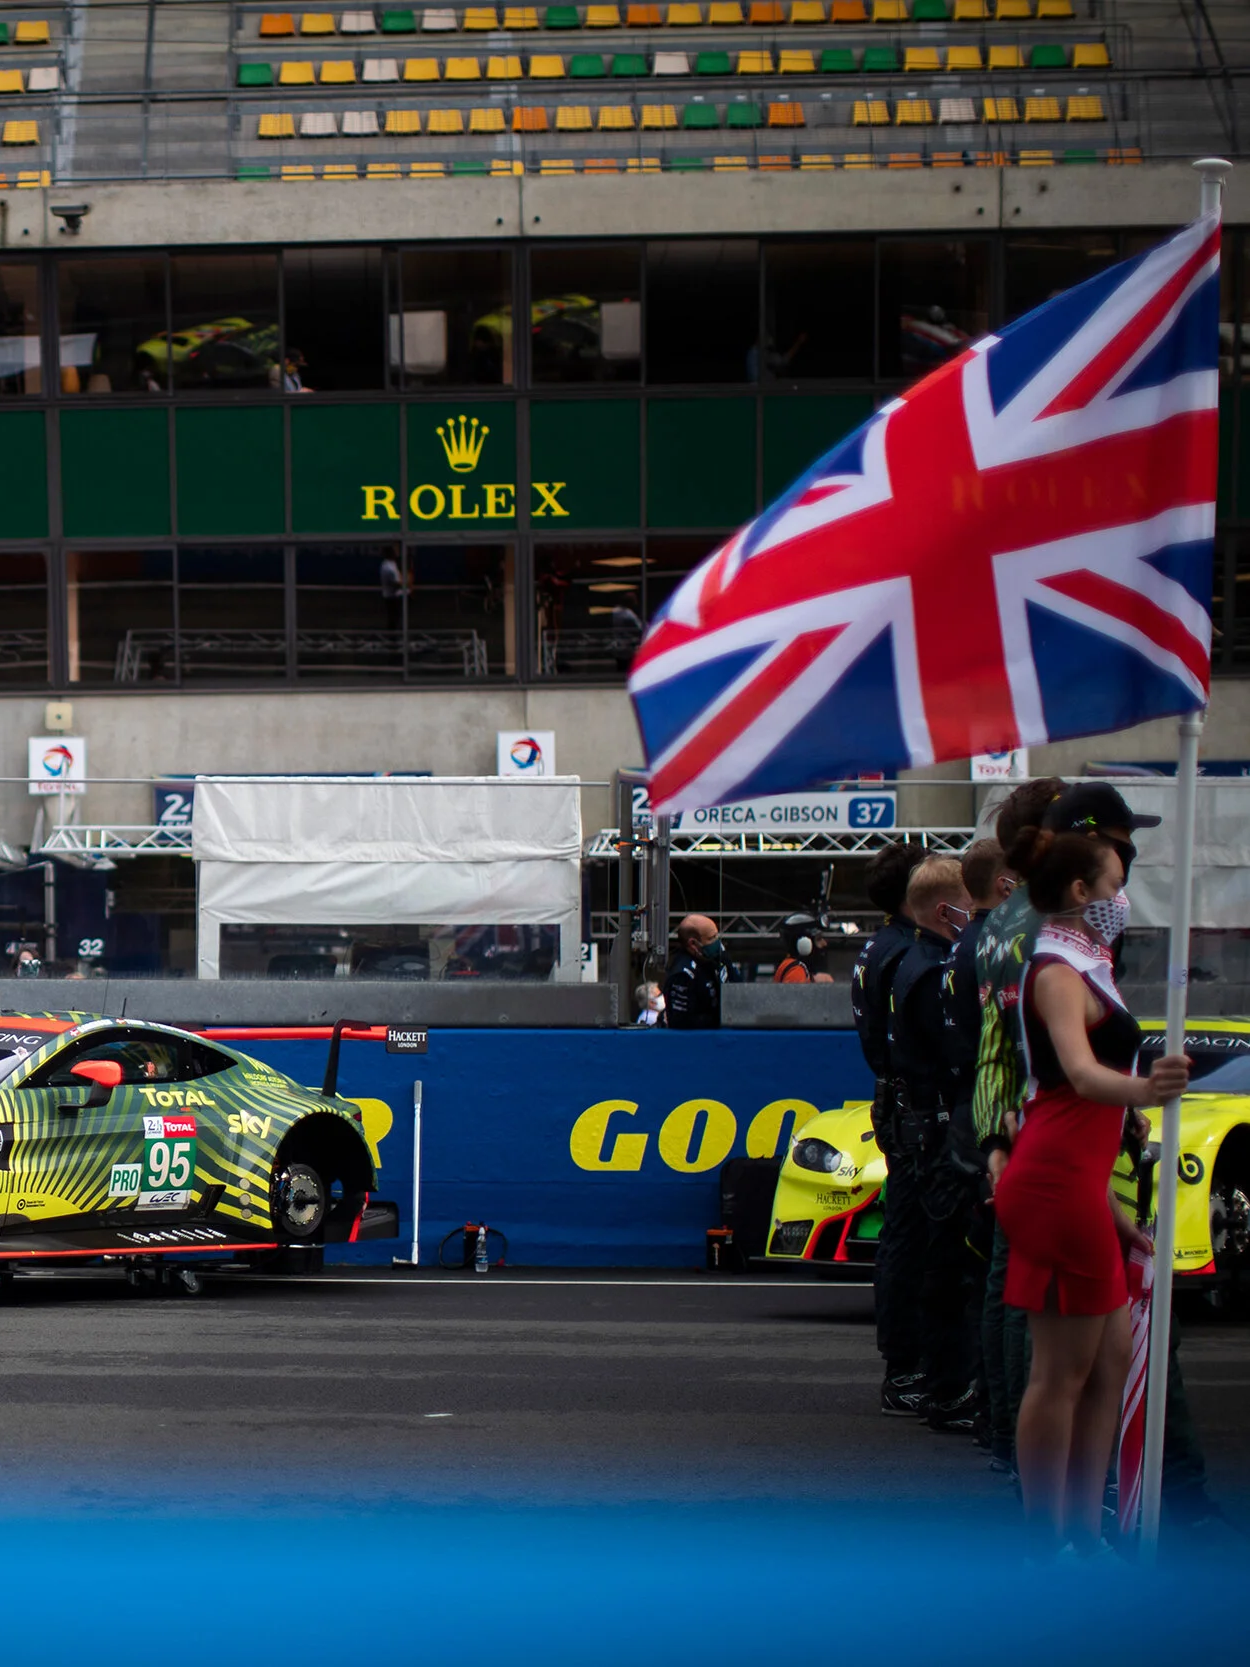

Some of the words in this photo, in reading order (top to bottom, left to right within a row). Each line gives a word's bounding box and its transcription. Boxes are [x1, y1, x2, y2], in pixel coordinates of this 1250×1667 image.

[362, 482, 570, 520] ROLEX
[693, 807, 755, 823] ORECA
[770, 805, 838, 822] GIBSON
[857, 803, 886, 824] 37
[77, 938, 104, 956] 32
[388, 1030, 427, 1042] HACKETT
[138, 1087, 216, 1108] TOTAL
[163, 1122, 195, 1133] TOTAL
[227, 1109, 272, 1139] sky
[147, 1141, 191, 1188] 95
[838, 1164, 863, 1180] sky
[110, 1168, 139, 1192] PRO
[149, 1191, 182, 1204] WEC
